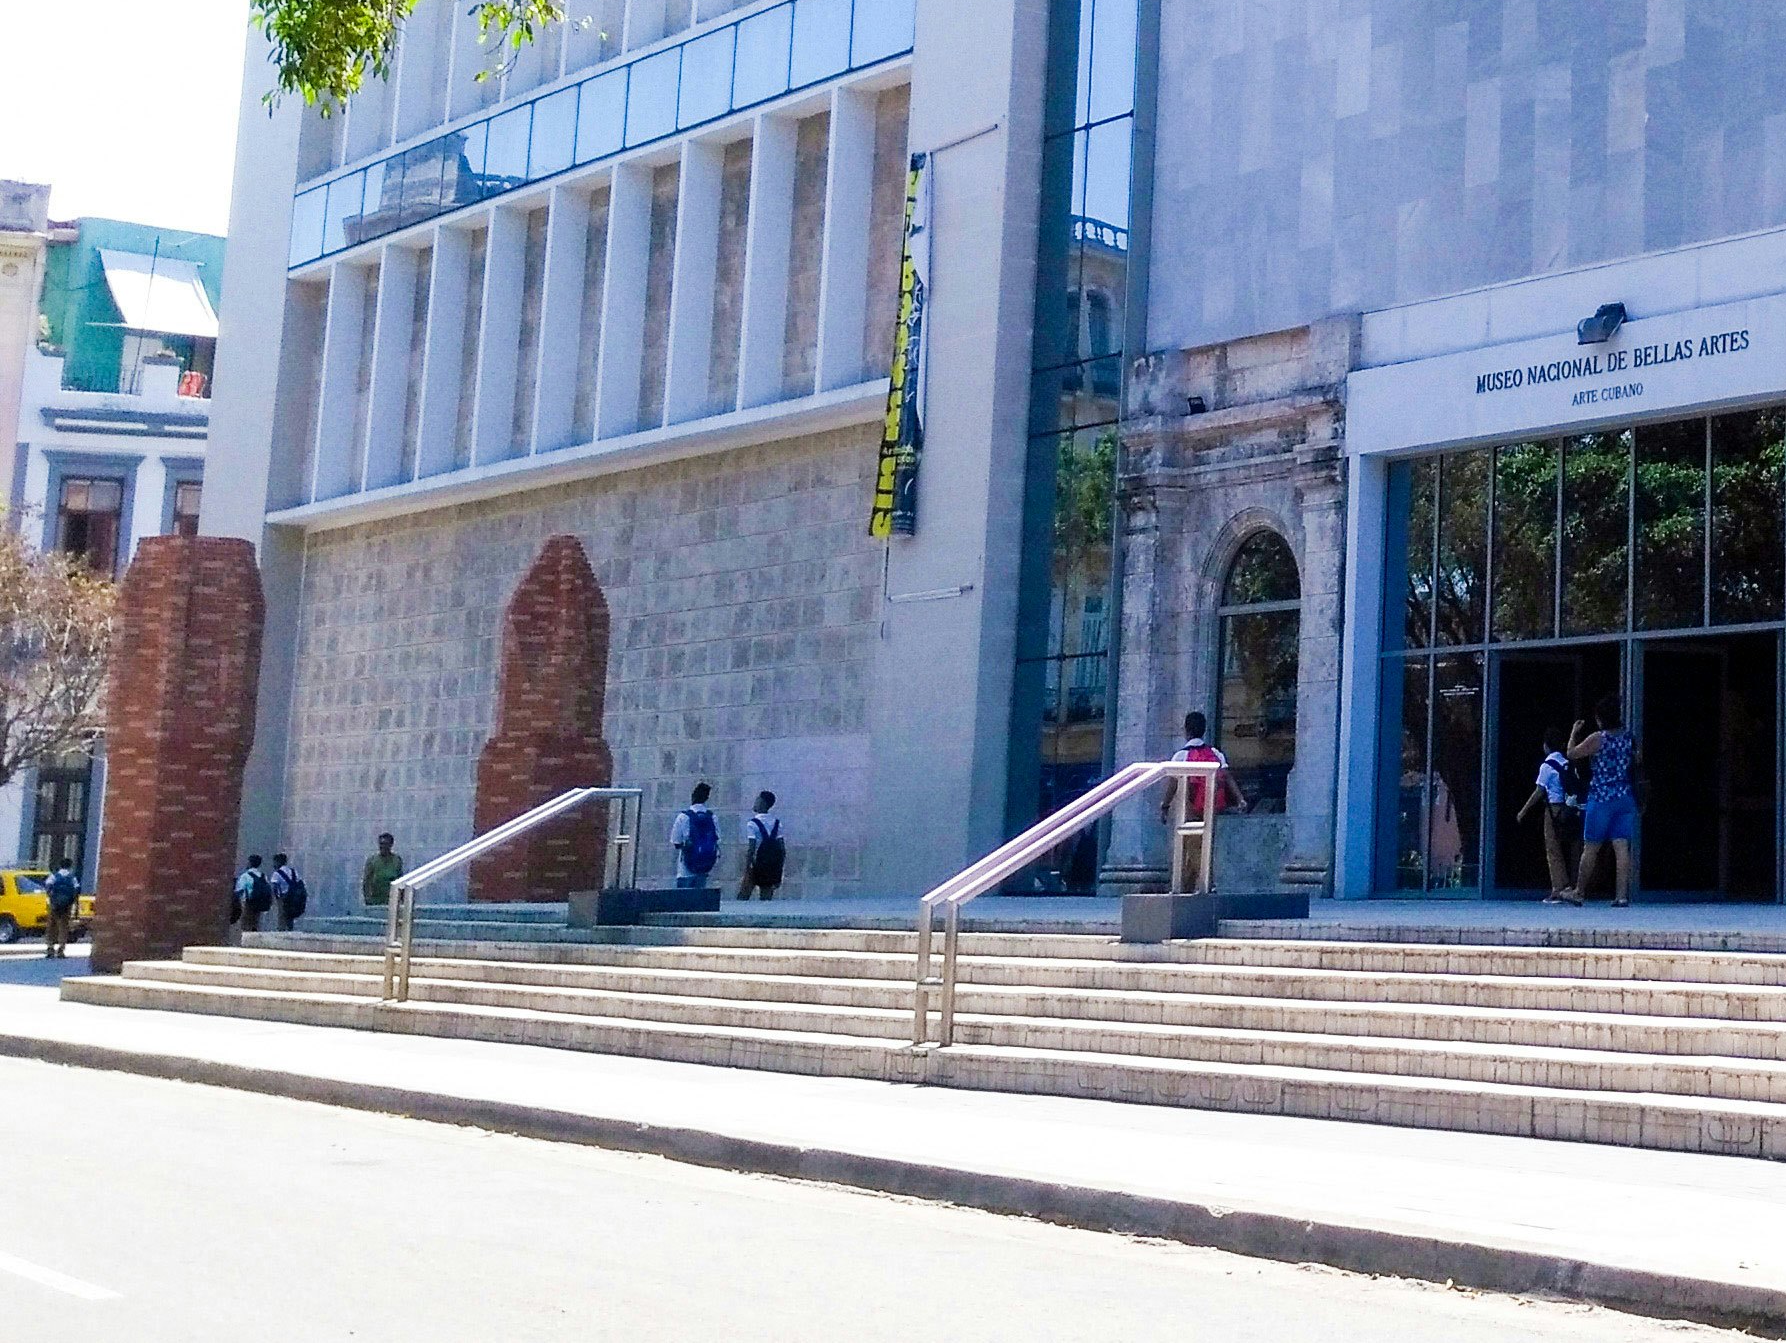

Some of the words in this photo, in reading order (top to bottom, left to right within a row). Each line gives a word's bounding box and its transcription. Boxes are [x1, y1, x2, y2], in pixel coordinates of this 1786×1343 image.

[1476, 368, 1523, 394] MUSEO
[1527, 355, 1603, 385] NACIONAL
[1607, 350, 1628, 373] DE
[1633, 339, 1693, 368] BELLAS
[1698, 329, 1750, 358] ARTES
[1571, 389, 1598, 406] ARTE
[1601, 382, 1644, 402] CUBANO
